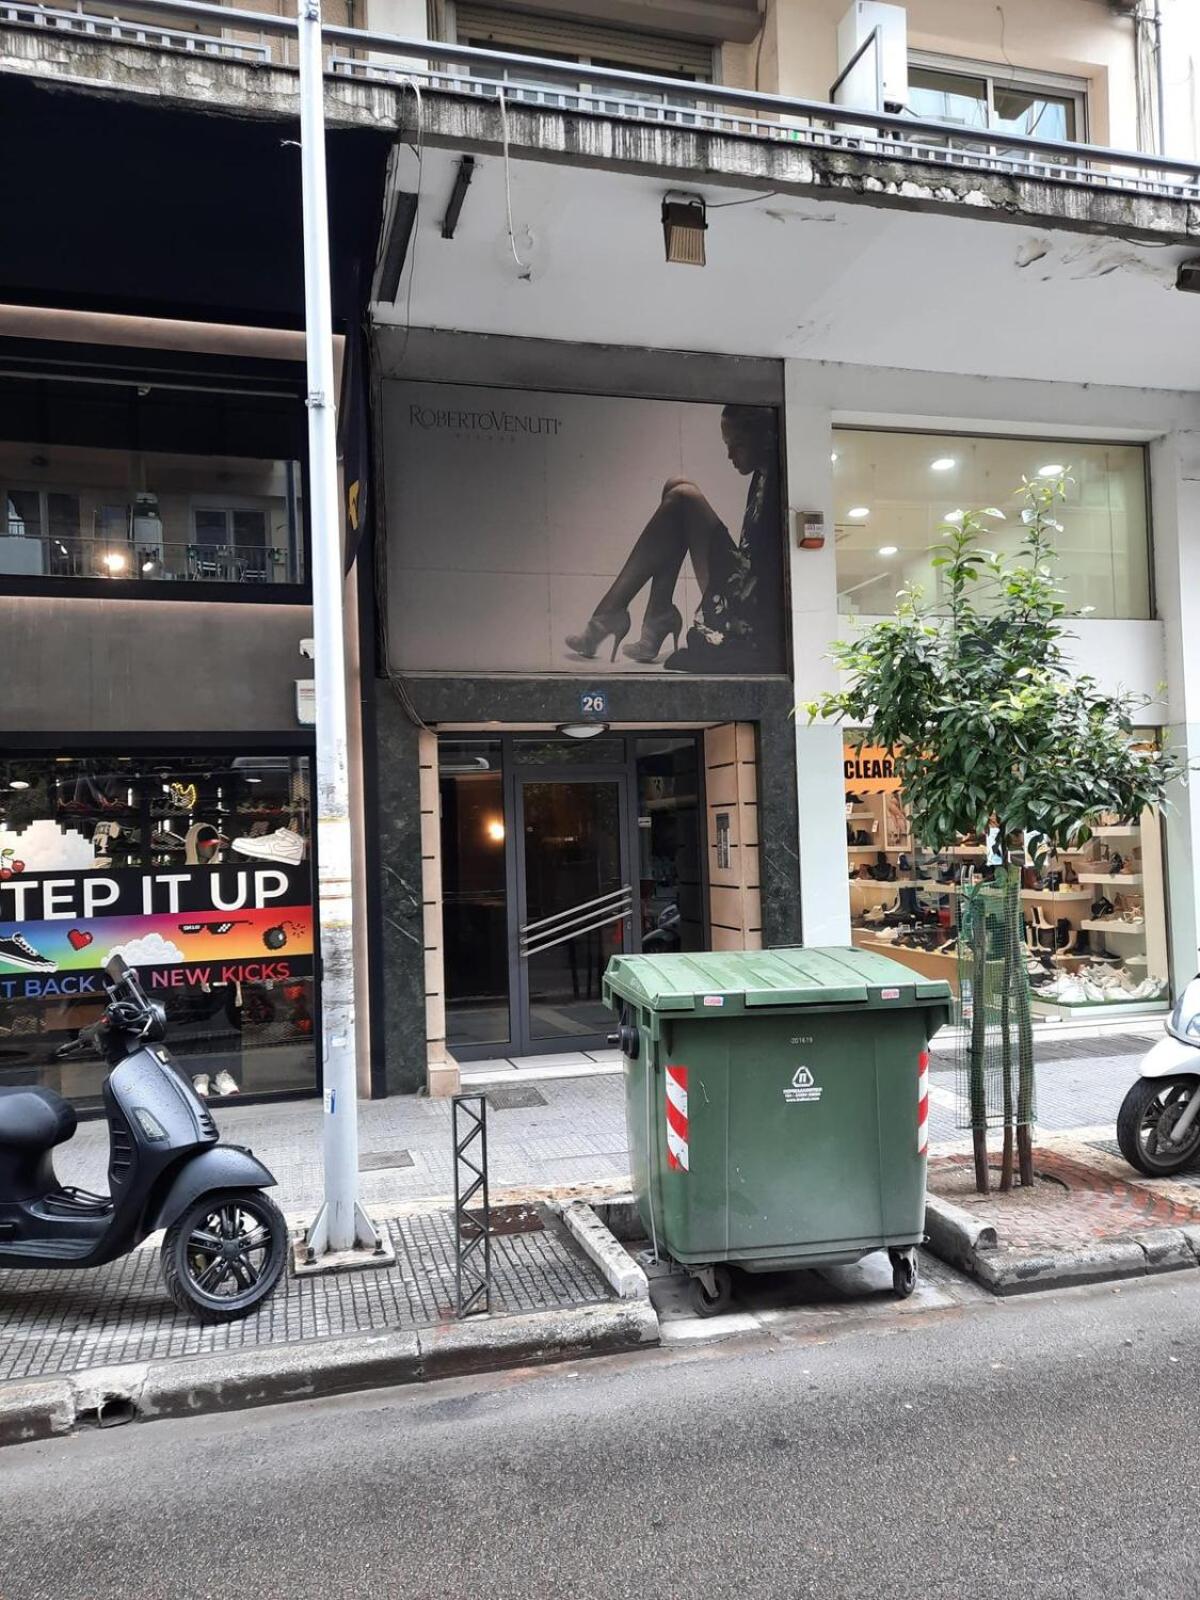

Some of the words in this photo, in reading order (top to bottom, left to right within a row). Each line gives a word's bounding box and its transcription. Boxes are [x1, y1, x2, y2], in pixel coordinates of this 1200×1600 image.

[583, 696, 603, 711] 26
[844, 759, 899, 779] CLEAR
[0, 877, 120, 922] TEP
[142, 874, 191, 915] IT
[210, 870, 289, 911] UP
[24, 975, 96, 998] BACK
[152, 967, 211, 988] NEW
[222, 962, 290, 984] KICKS
